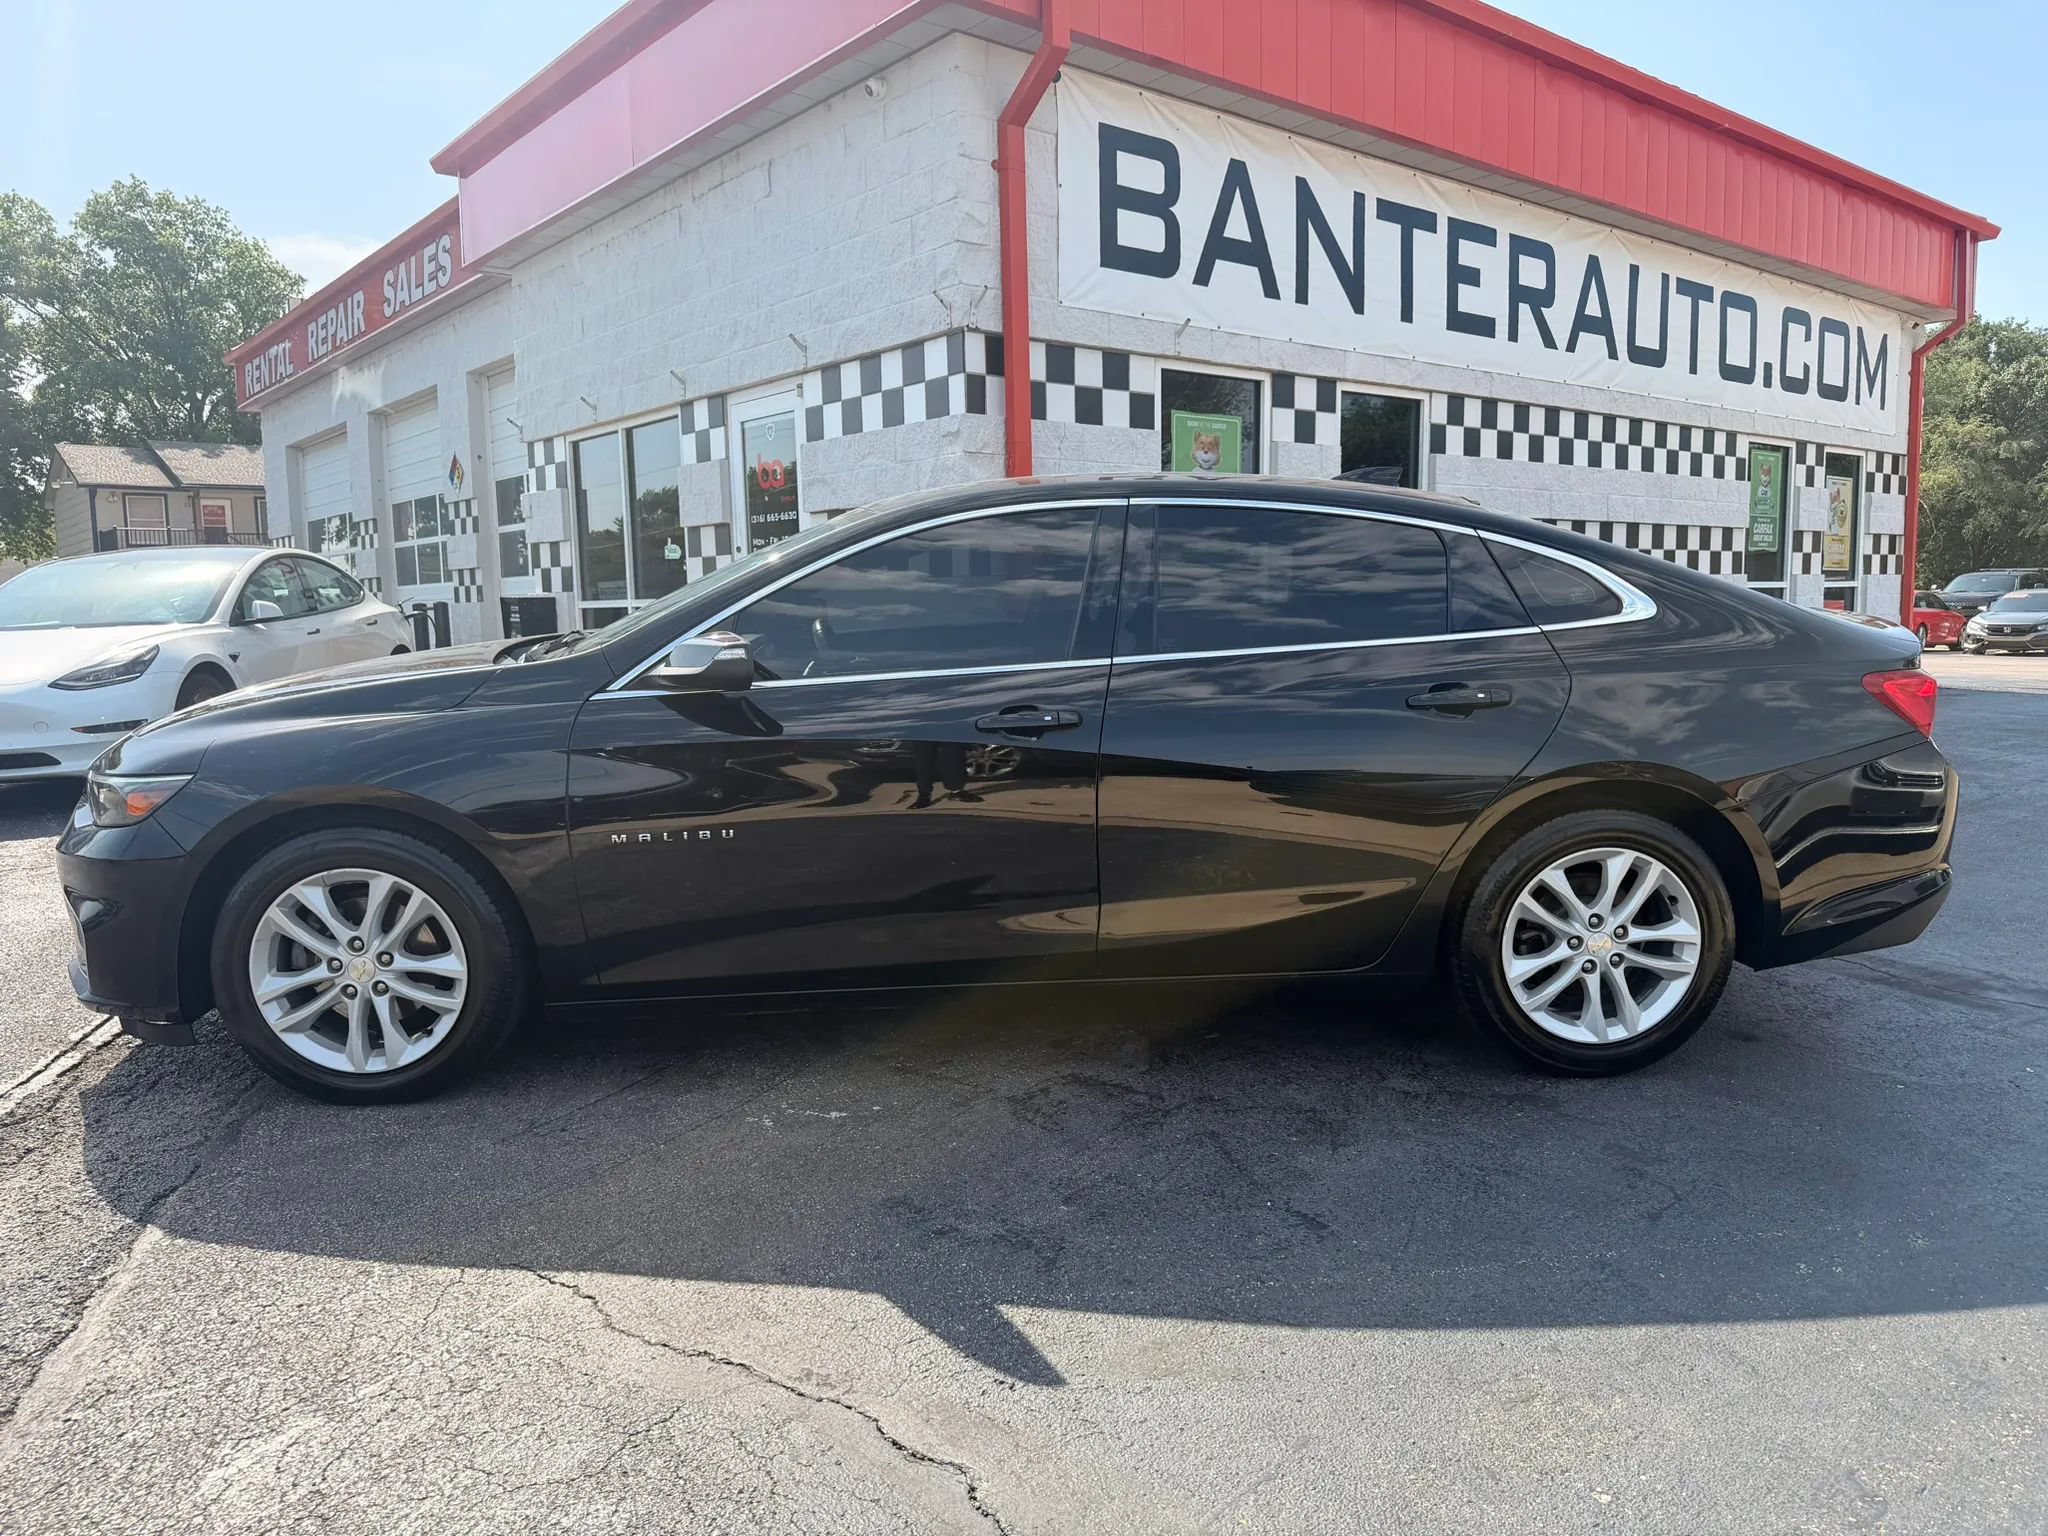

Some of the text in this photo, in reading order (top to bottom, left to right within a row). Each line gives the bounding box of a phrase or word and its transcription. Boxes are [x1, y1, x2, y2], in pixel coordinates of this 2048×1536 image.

[245, 234, 452, 397] RENTAL REPAIR SALES
[1098, 121, 1889, 411] BANTERAUTO.COM
[611, 829, 734, 843] MALIBU
